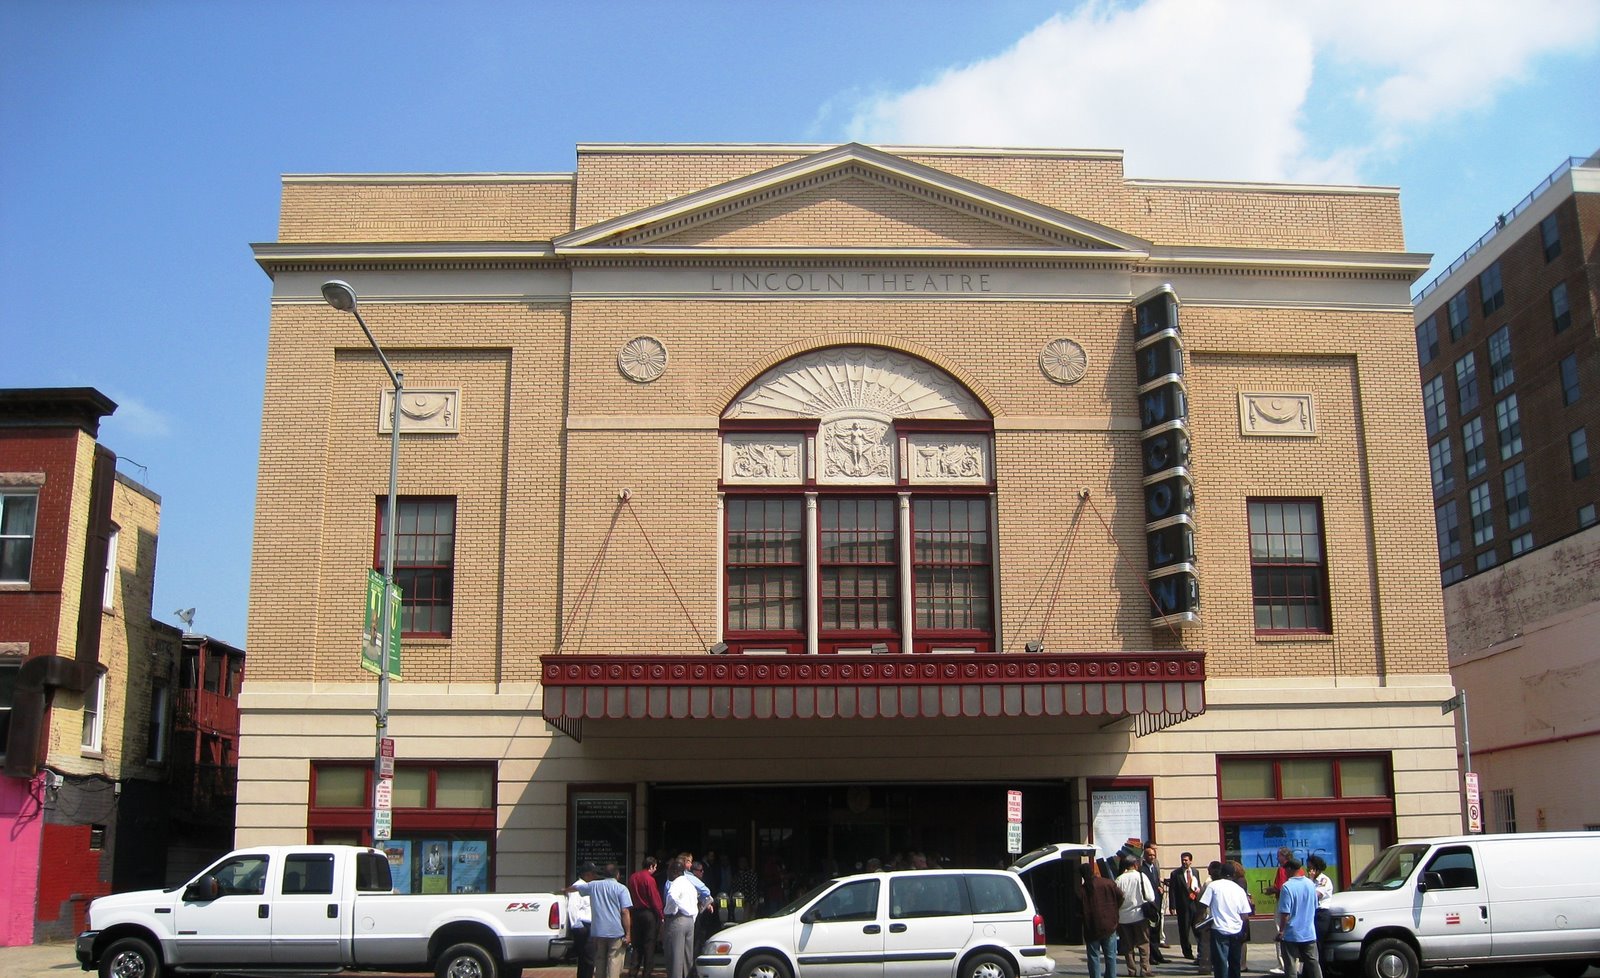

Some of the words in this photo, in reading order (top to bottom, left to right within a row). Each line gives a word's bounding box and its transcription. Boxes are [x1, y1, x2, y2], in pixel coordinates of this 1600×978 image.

[711, 273, 845, 291] LINCOLN
[861, 273, 991, 291] THEATRE
[1138, 304, 1178, 612] LINCOLN
[1291, 838, 1309, 848] THE
